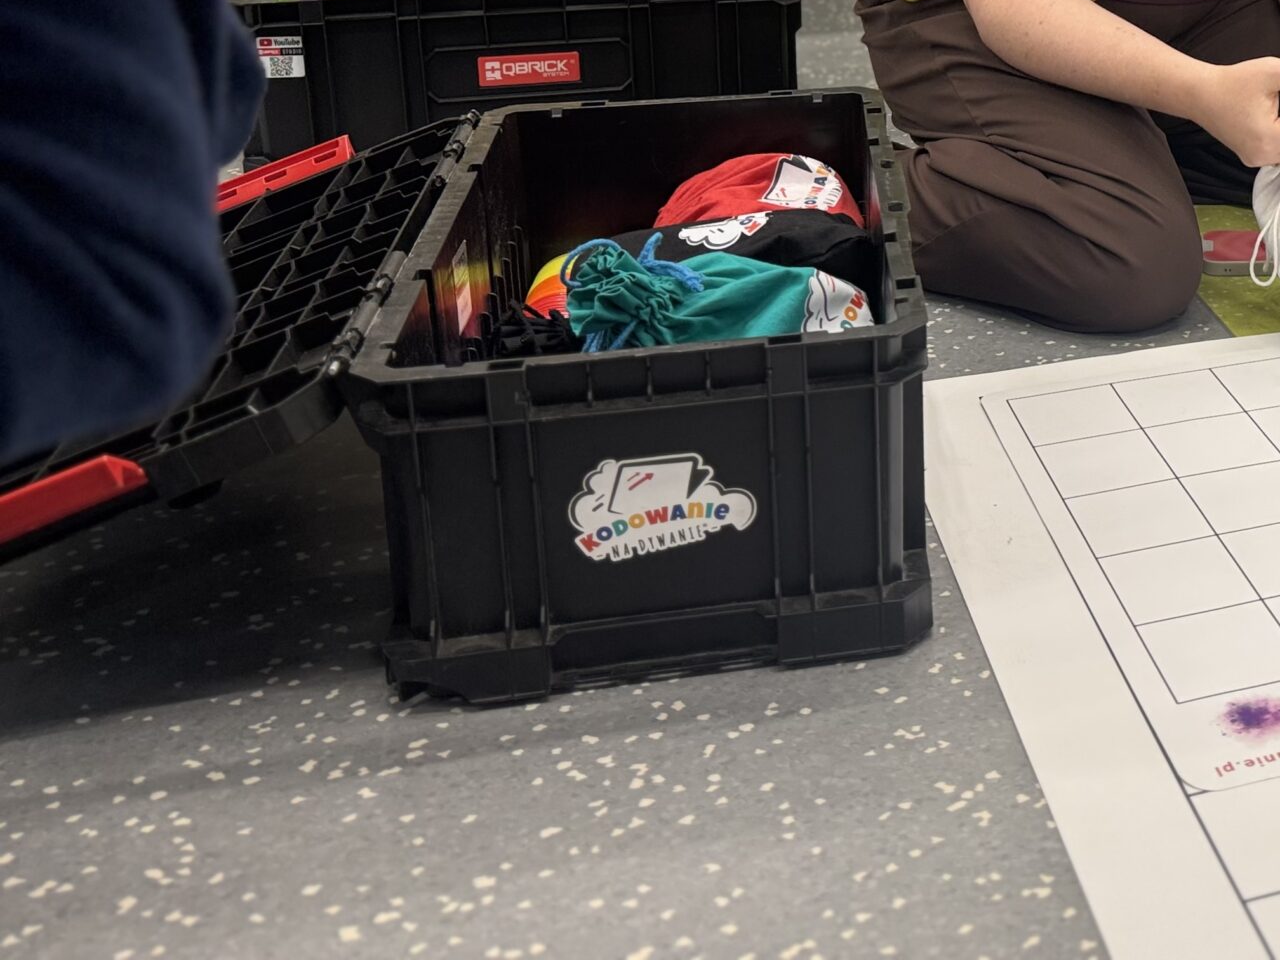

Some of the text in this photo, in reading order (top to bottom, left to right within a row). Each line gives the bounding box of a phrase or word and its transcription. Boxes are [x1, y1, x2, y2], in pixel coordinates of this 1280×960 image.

[272, 38, 301, 46] YouTube
[502, 59, 569, 77] QBRICK
[611, 545, 632, 559] NA
